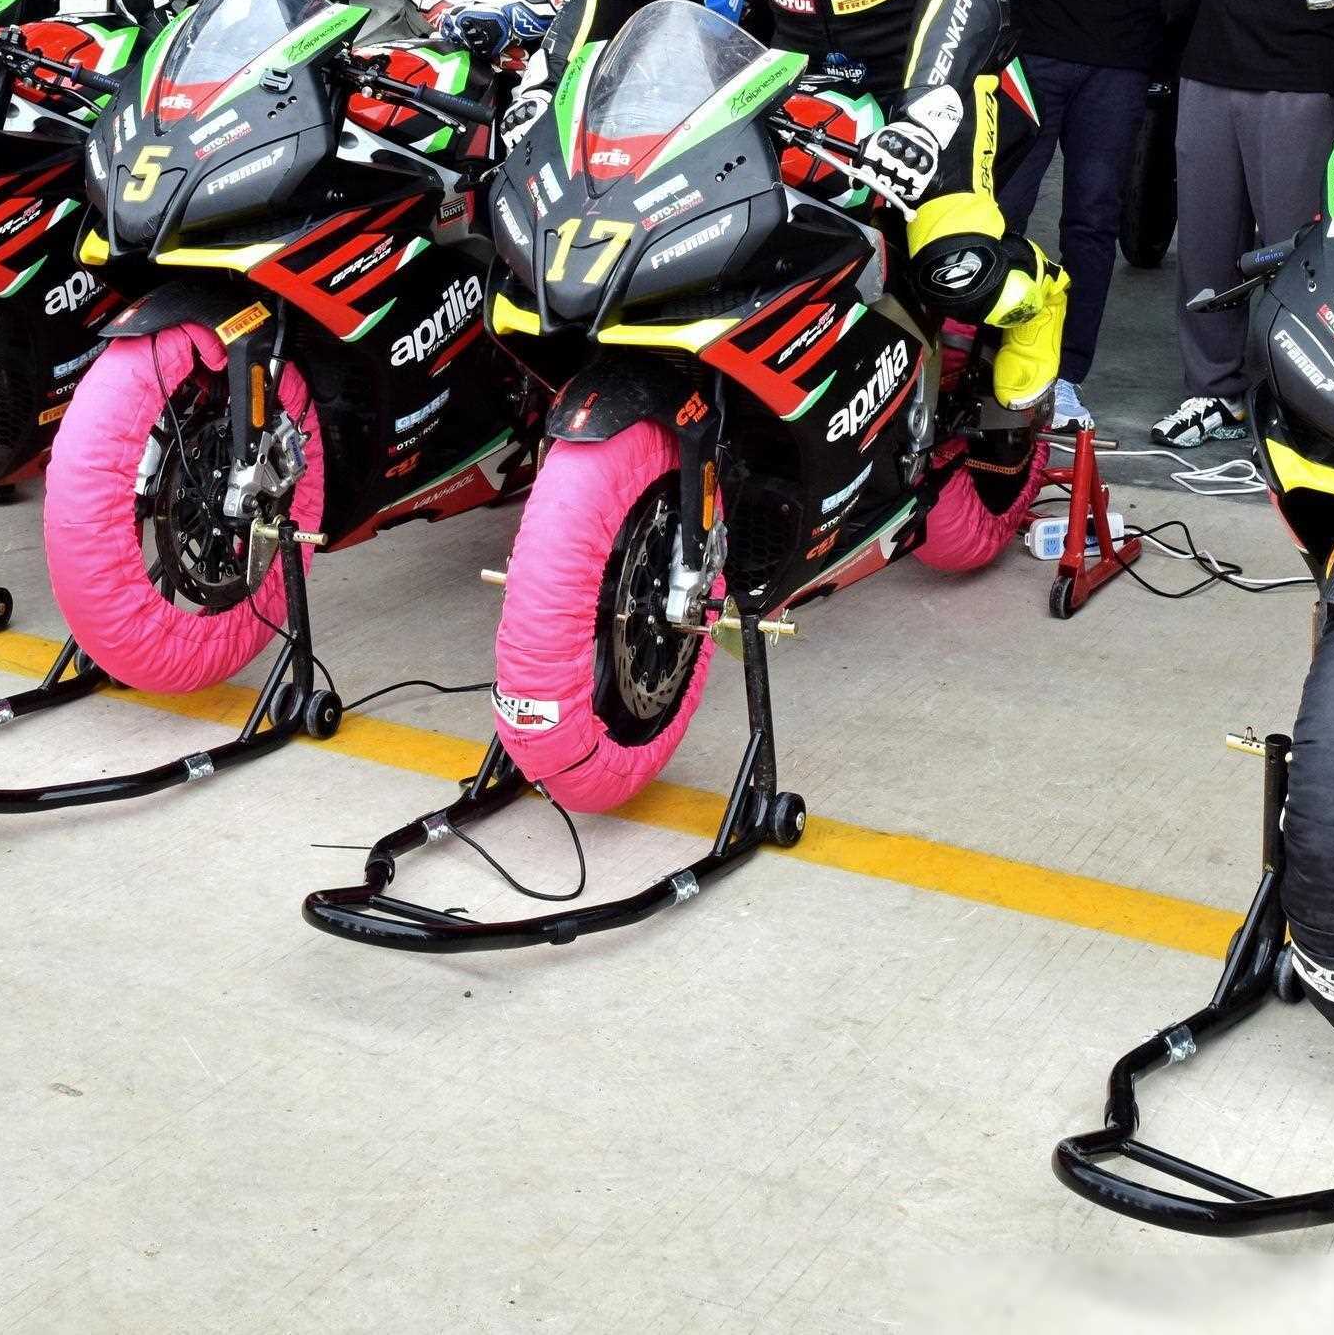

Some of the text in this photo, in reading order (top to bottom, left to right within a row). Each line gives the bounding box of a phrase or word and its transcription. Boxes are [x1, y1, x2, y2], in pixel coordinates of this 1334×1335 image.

[744, 65, 788, 105] alpinestars
[122, 146, 172, 203] 5
[590, 148, 632, 167] aprilia
[642, 190, 703, 231] MOTO-TRON
[545, 217, 637, 285] 17
[391, 275, 484, 367] aprilia
[676, 391, 702, 428] CST
[825, 339, 909, 443] aprilia
[389, 418, 441, 456] MOTO-TRON
[412, 474, 475, 510] VANHOOL
